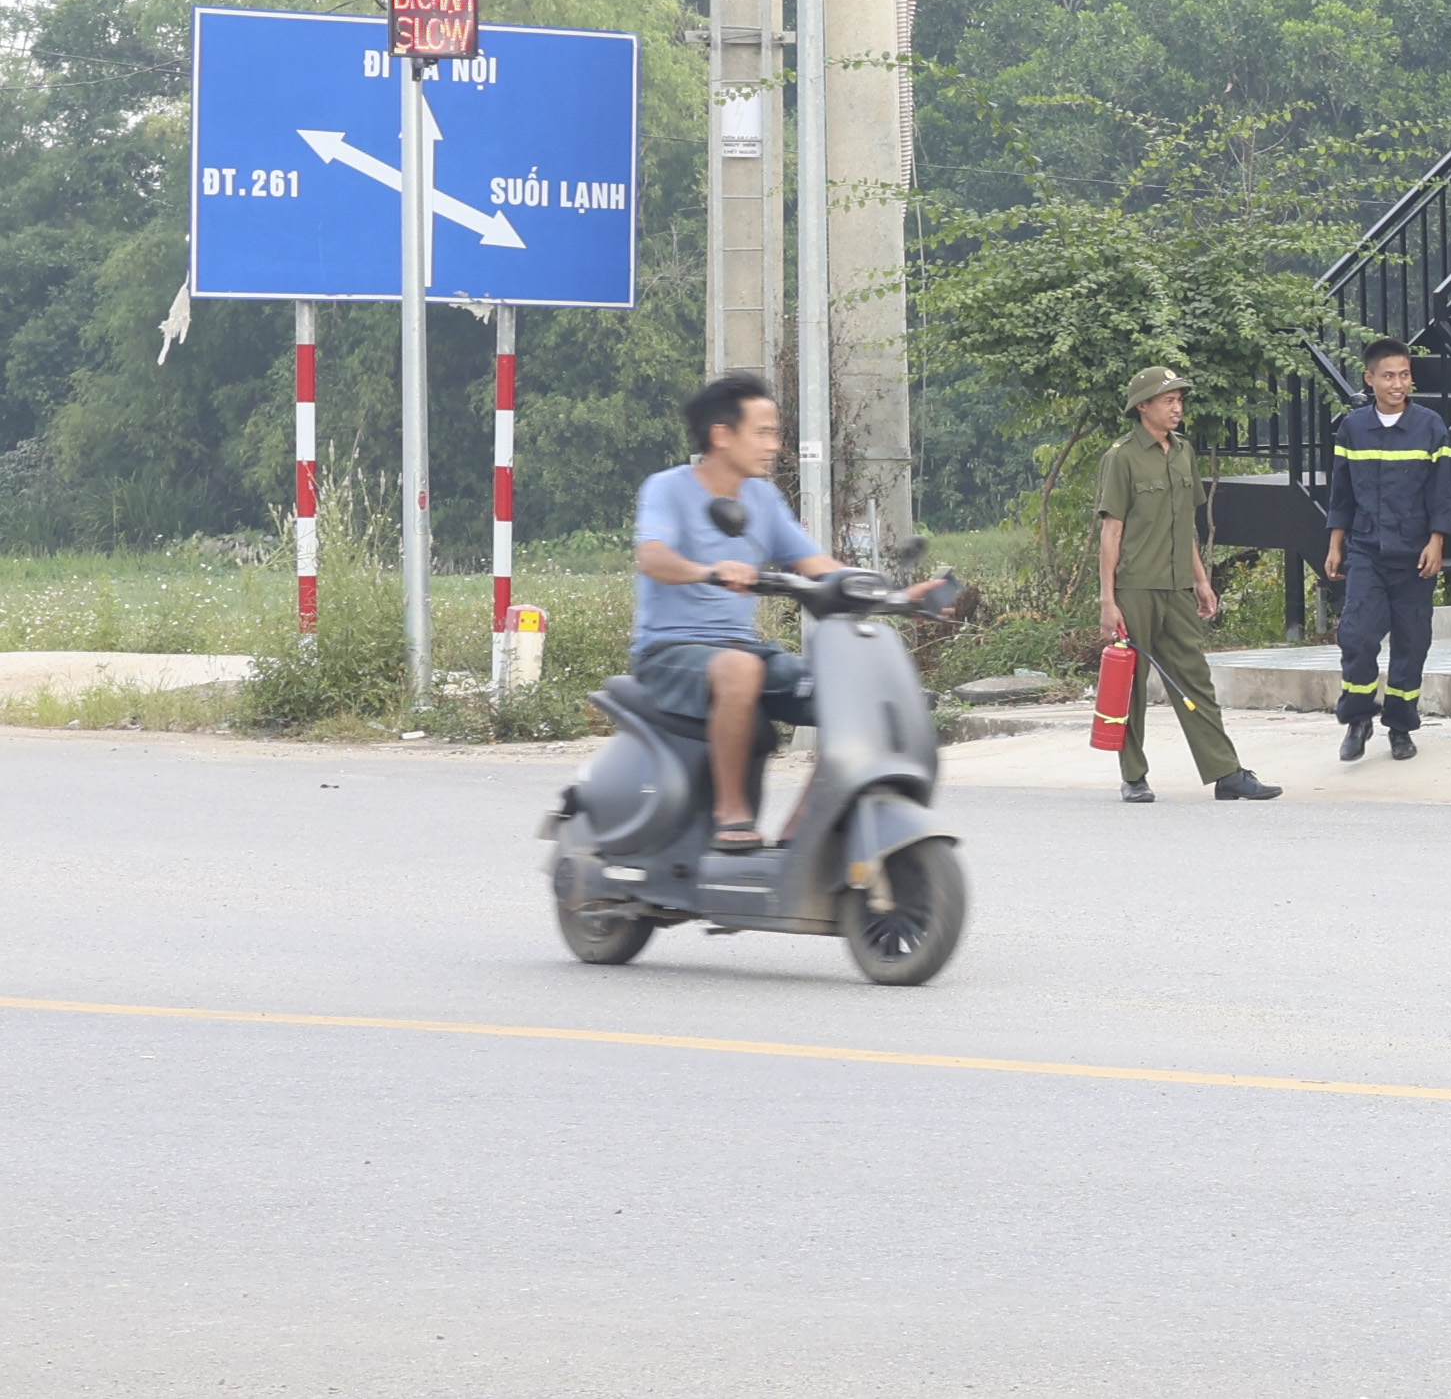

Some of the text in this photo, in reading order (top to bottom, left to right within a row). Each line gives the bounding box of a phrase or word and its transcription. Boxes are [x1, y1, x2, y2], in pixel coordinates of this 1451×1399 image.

[396, 16, 474, 52] SLOW
[363, 49, 391, 78] ĐI
[452, 49, 497, 90] NỘI
[490, 166, 626, 214] SUỐI LẠNH
